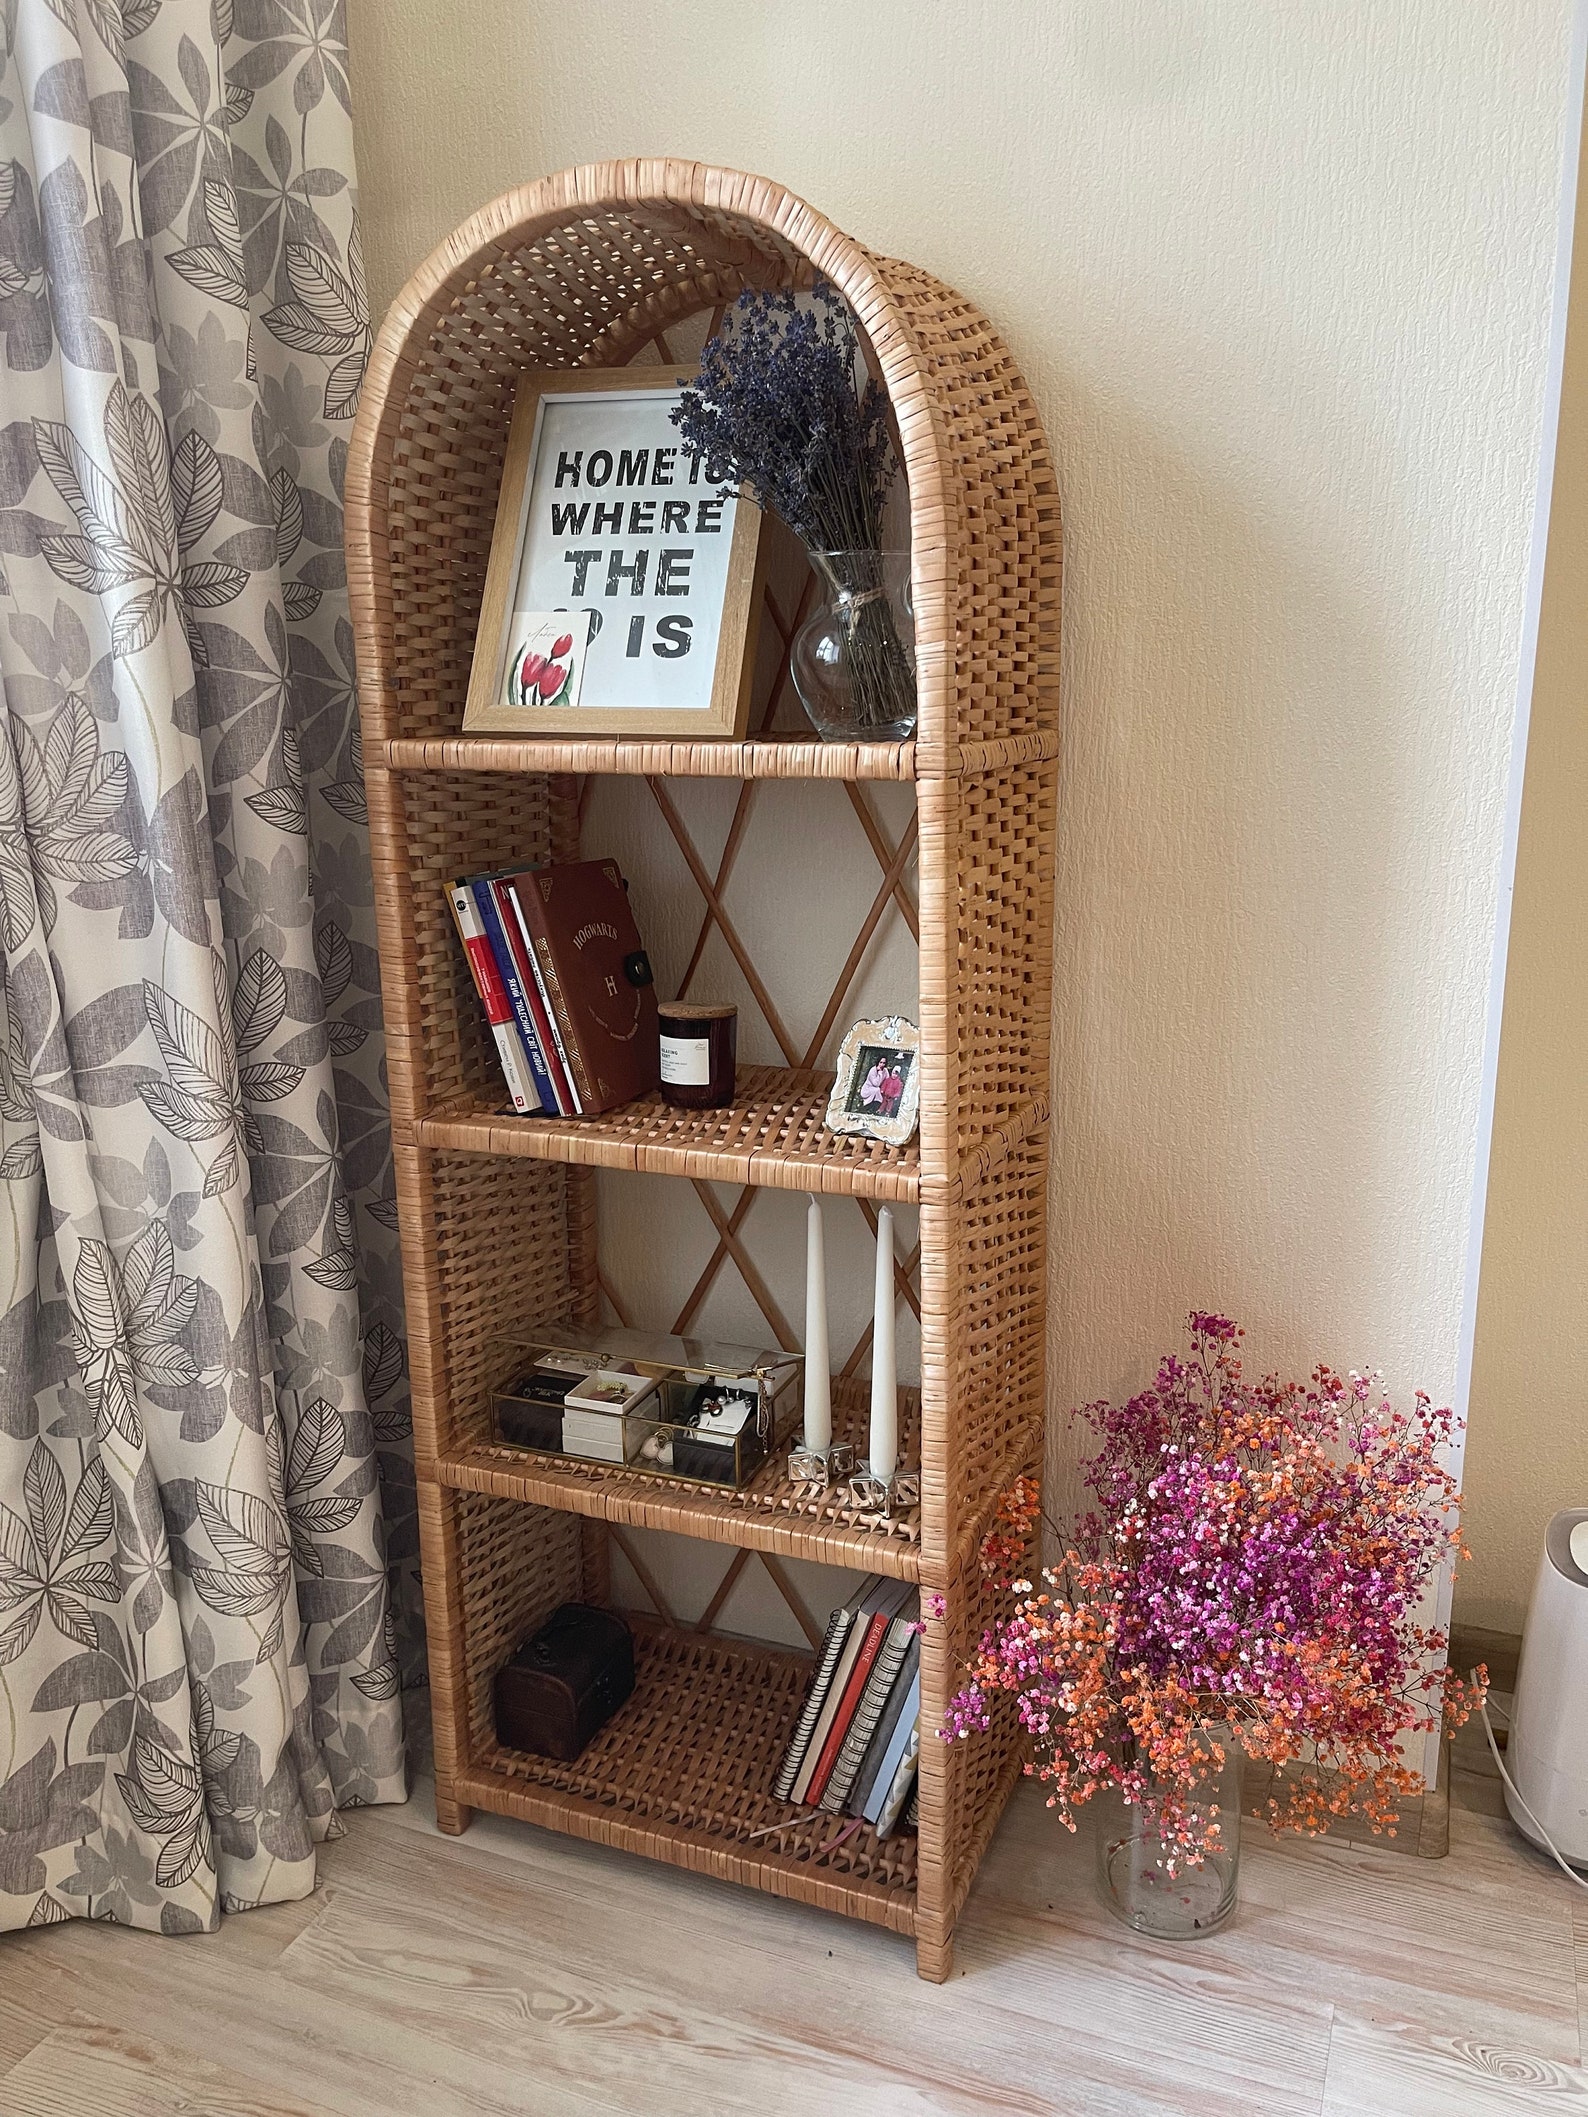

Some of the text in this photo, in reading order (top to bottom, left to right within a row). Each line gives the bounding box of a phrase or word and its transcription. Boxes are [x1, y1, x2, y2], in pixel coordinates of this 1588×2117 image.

[554, 447, 678, 489] HOME
[551, 500, 725, 536] WHERE
[564, 549, 695, 597] THE
[625, 614, 694, 659] IS
[572, 922, 618, 951] HOGWARTS
[604, 975, 618, 997] H
[507, 978, 547, 1076] ЯКИЙ ЧУДЕСНИЙ СВІТ НОВИЙ!
[862, 1623, 882, 1664] DEADLINE
